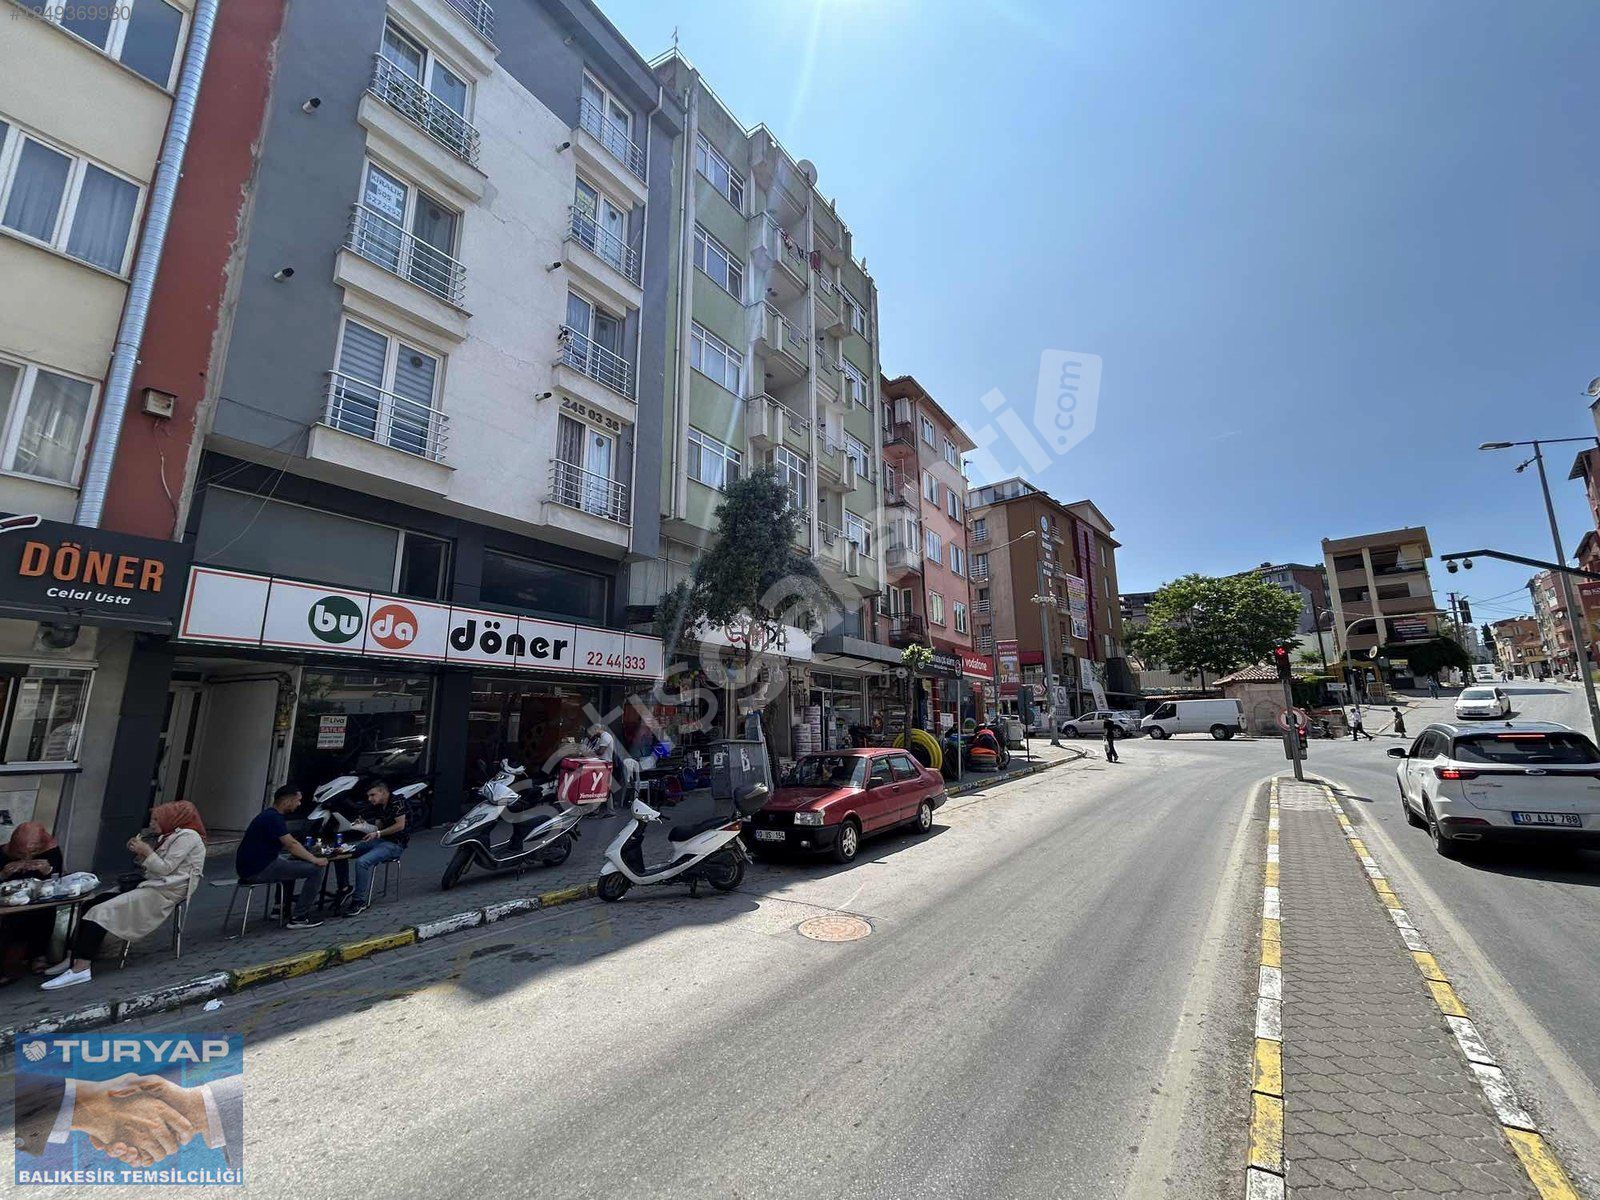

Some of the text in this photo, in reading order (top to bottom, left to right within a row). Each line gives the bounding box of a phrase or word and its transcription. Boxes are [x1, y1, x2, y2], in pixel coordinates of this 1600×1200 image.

[562, 396, 586, 416] 245
[588, 409, 603, 424] 03
[19, 540, 165, 592] DÖNER
[46, 587, 132, 605] Celal Usta
[313, 604, 568, 660] bu da döner
[587, 651, 603, 666] 22
[1520, 813, 1532, 823] 10
